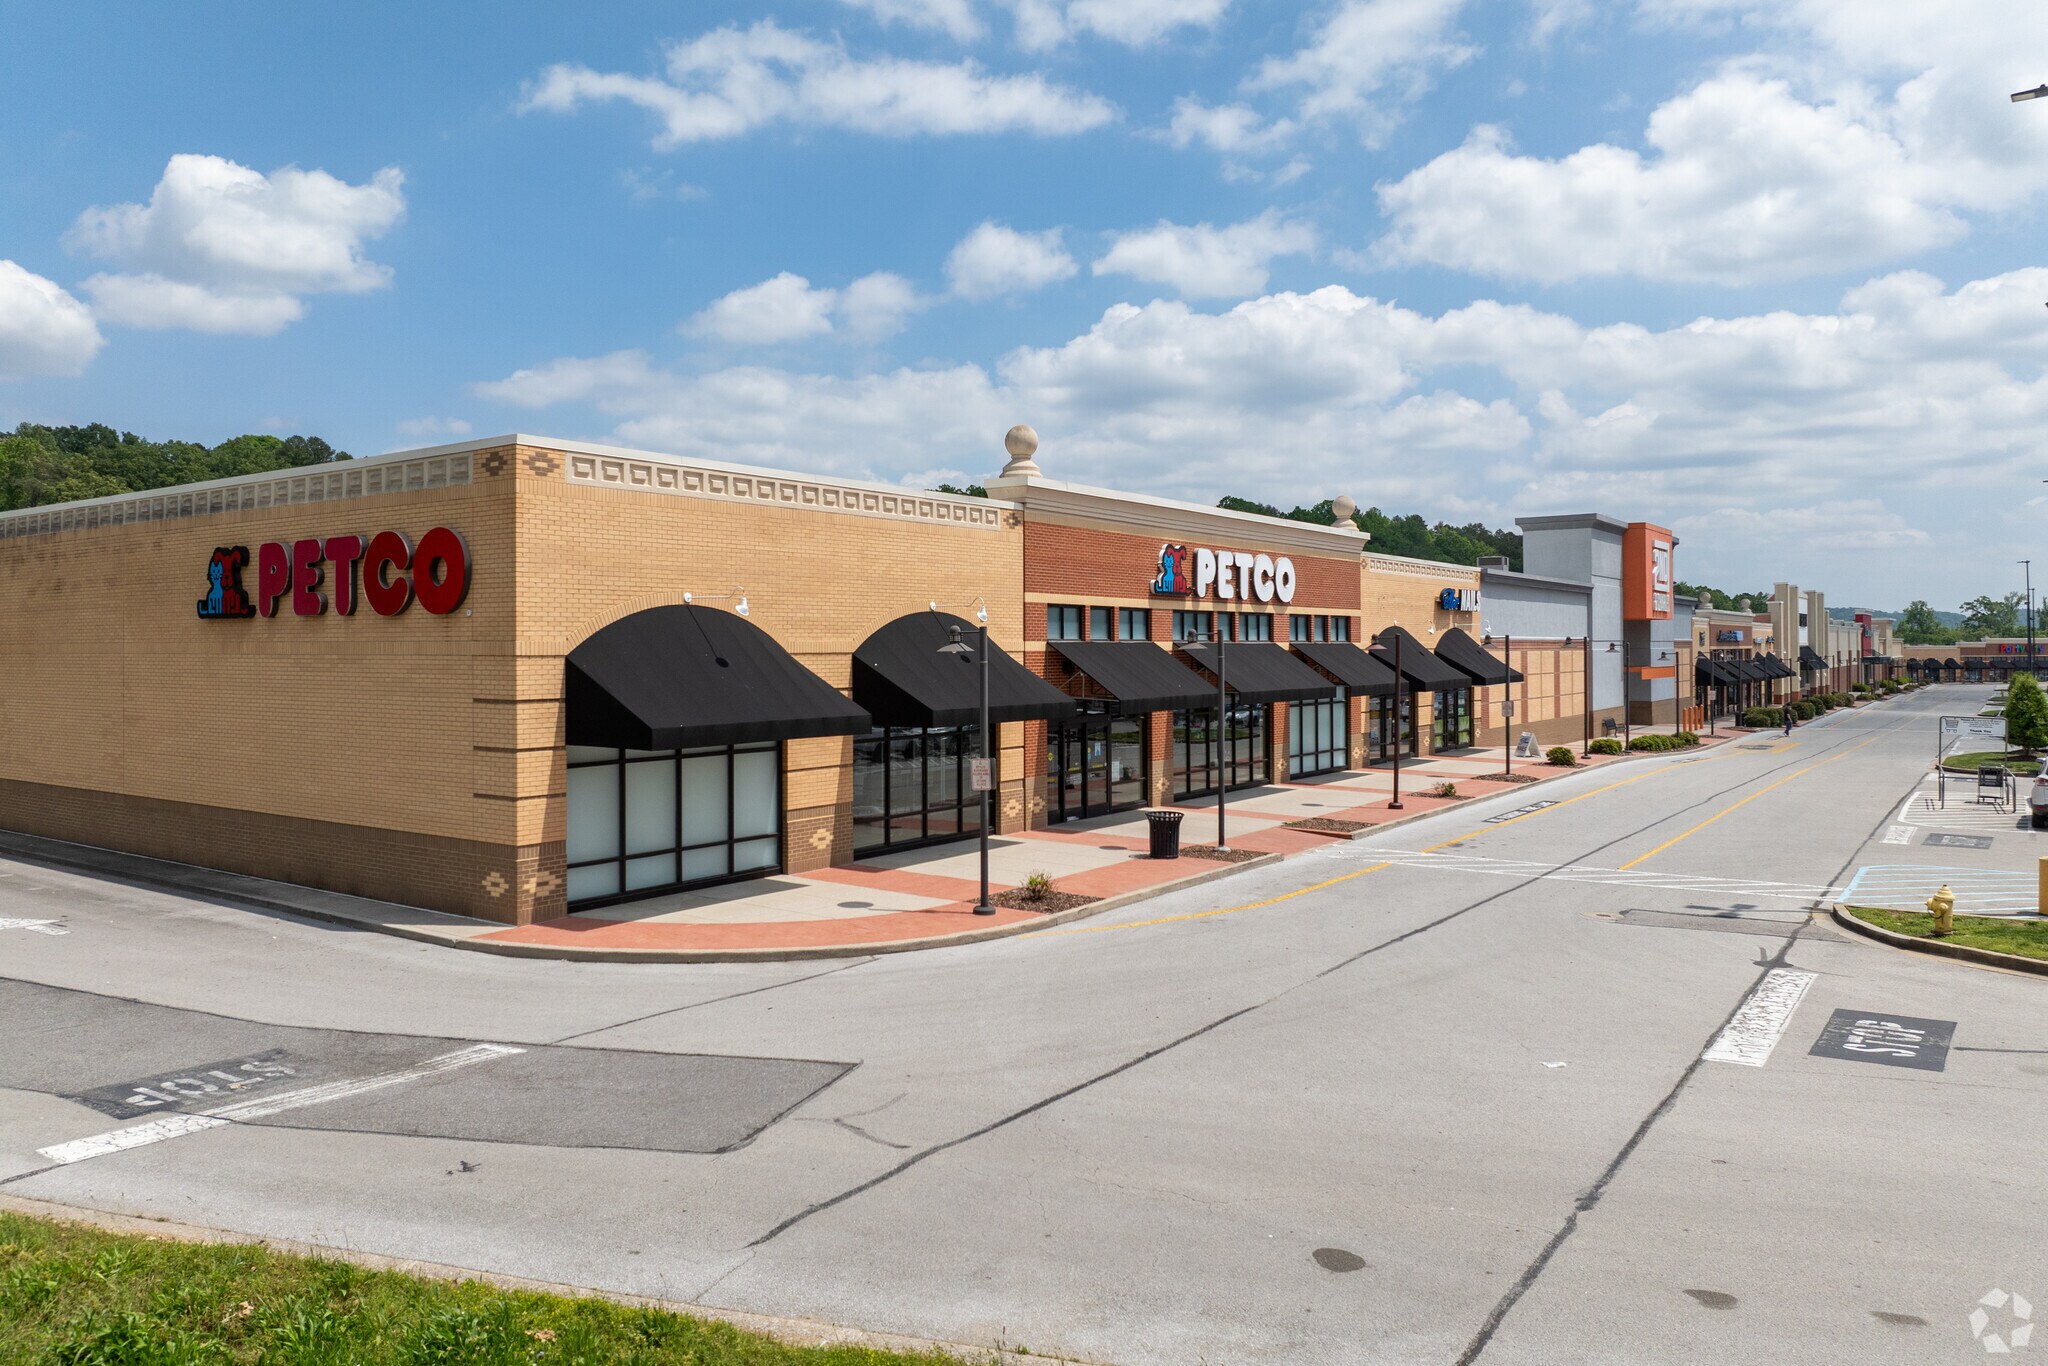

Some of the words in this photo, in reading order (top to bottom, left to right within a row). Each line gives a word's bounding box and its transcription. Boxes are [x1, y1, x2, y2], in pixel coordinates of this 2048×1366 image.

[258, 527, 472, 618] PETCO
[1194, 548, 1296, 603] PETCO
[1460, 589, 1482, 612] NAILS
[2000, 643, 2025, 654] Party
[1842, 1019, 1926, 1058] STOP
[126, 1061, 295, 1106] STOP
